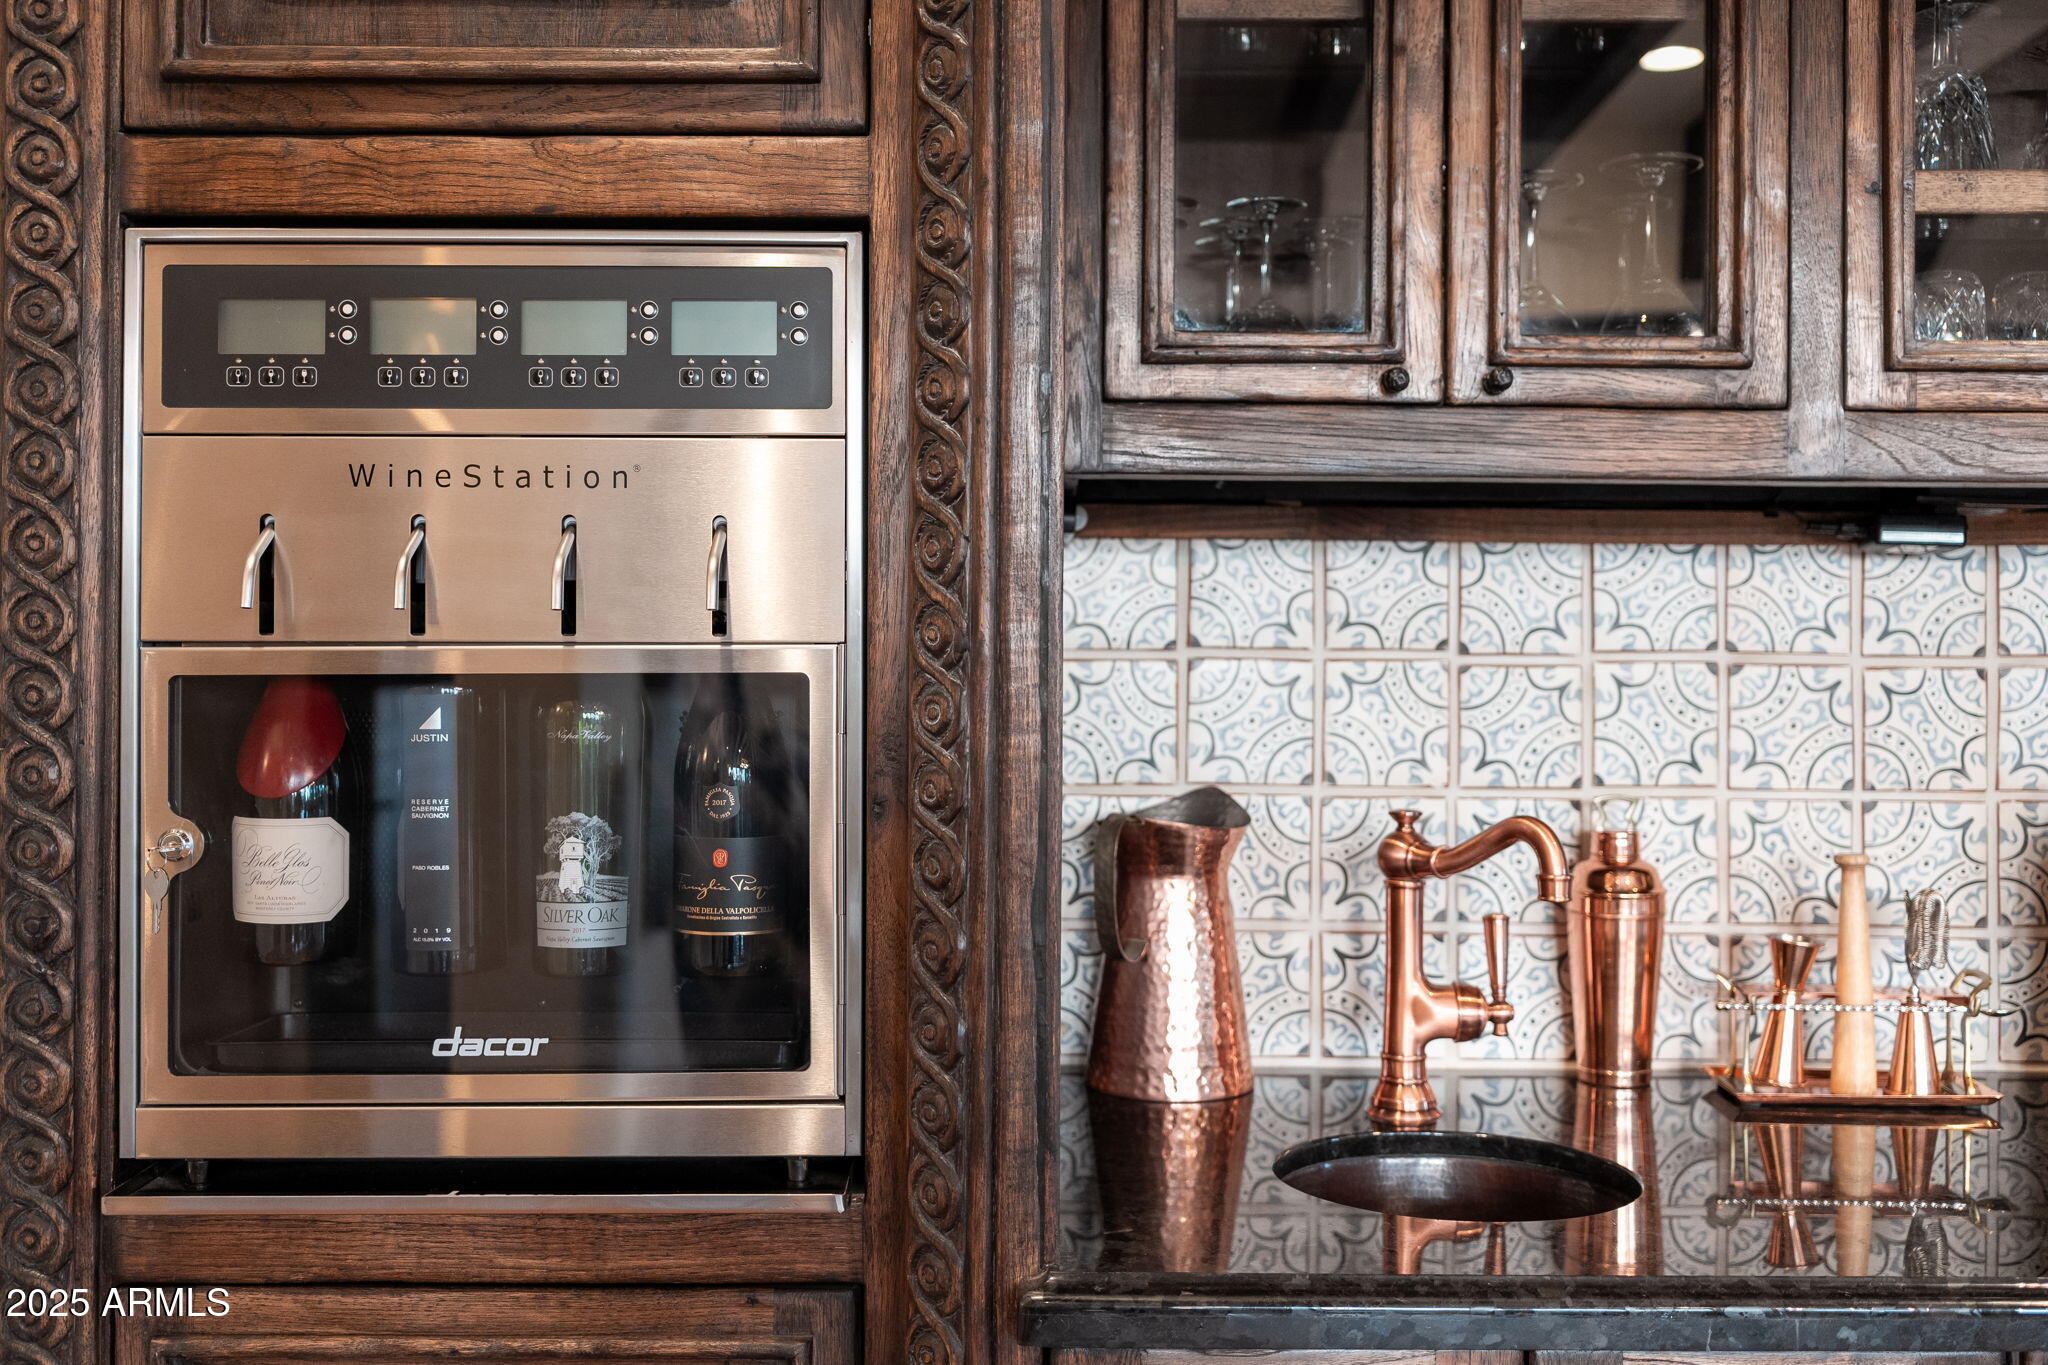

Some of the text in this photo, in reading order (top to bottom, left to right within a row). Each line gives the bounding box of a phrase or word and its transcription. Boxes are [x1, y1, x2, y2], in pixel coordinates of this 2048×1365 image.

[410, 733, 449, 742] JUSTIN
[547, 728, 612, 743] Napa Valley
[704, 787, 736, 807] FAMIGLIA PASQUA
[248, 870, 276, 889] Pinot
[543, 906, 619, 924] SILVER OAK
[432, 1026, 549, 1056] dacor
